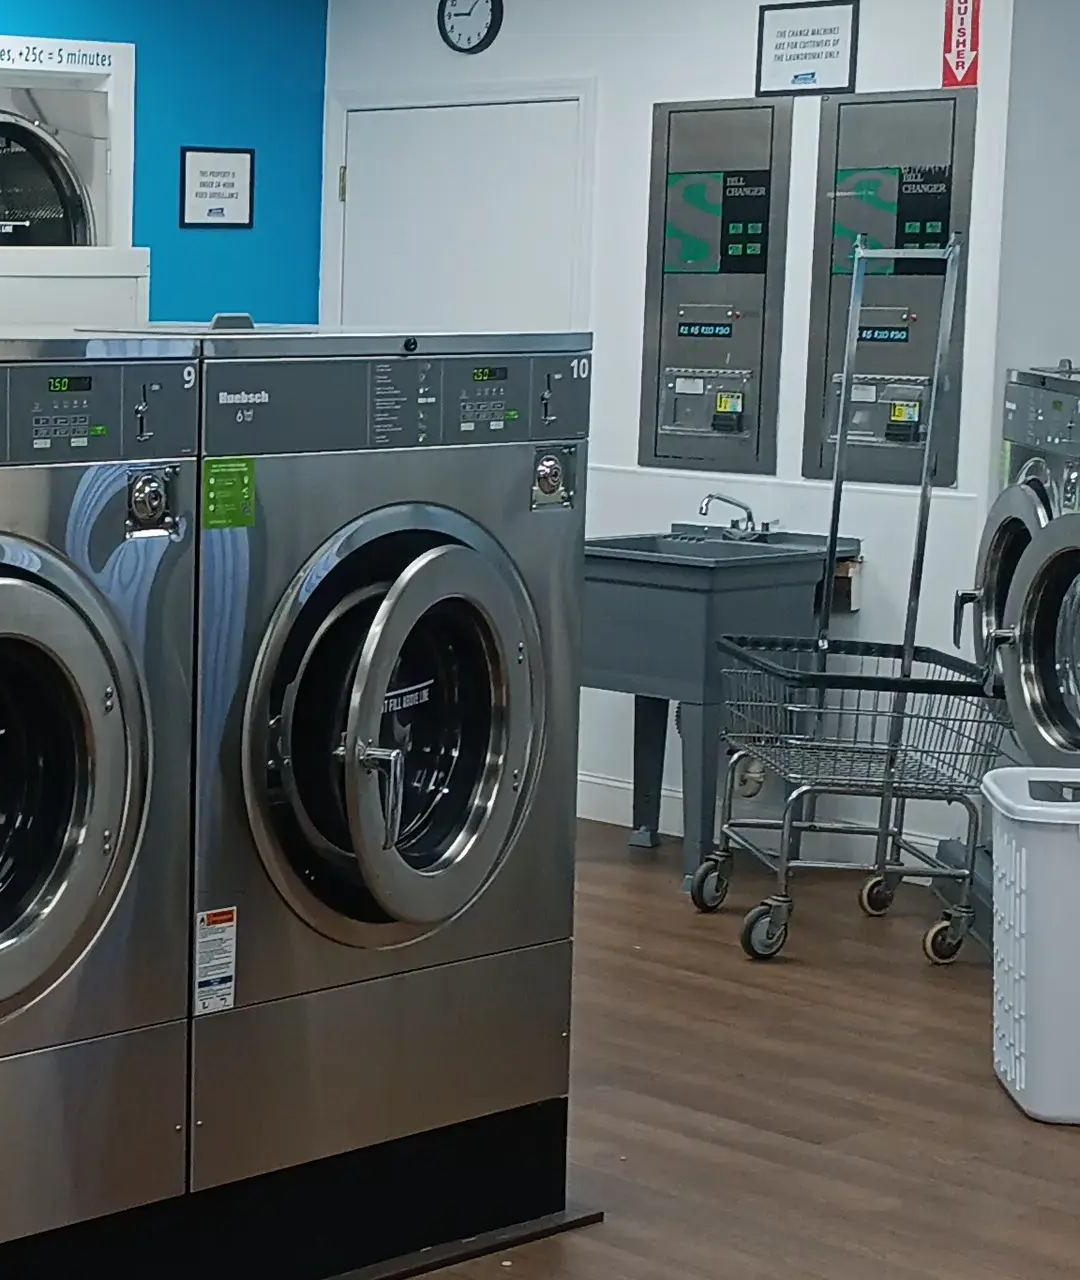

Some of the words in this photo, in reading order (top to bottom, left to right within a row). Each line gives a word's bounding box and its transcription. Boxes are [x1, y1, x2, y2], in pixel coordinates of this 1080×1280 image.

[57, 47, 63, 64] 5
[66, 50, 112, 67] minutes
[726, 187, 766, 196] CHANGER
[902, 184, 946, 194] CHANGER
[570, 359, 589, 379] 10
[183, 366, 195, 389] 9
[219, 390, 269, 404] Huebsch
[236, 409, 244, 423] 6
